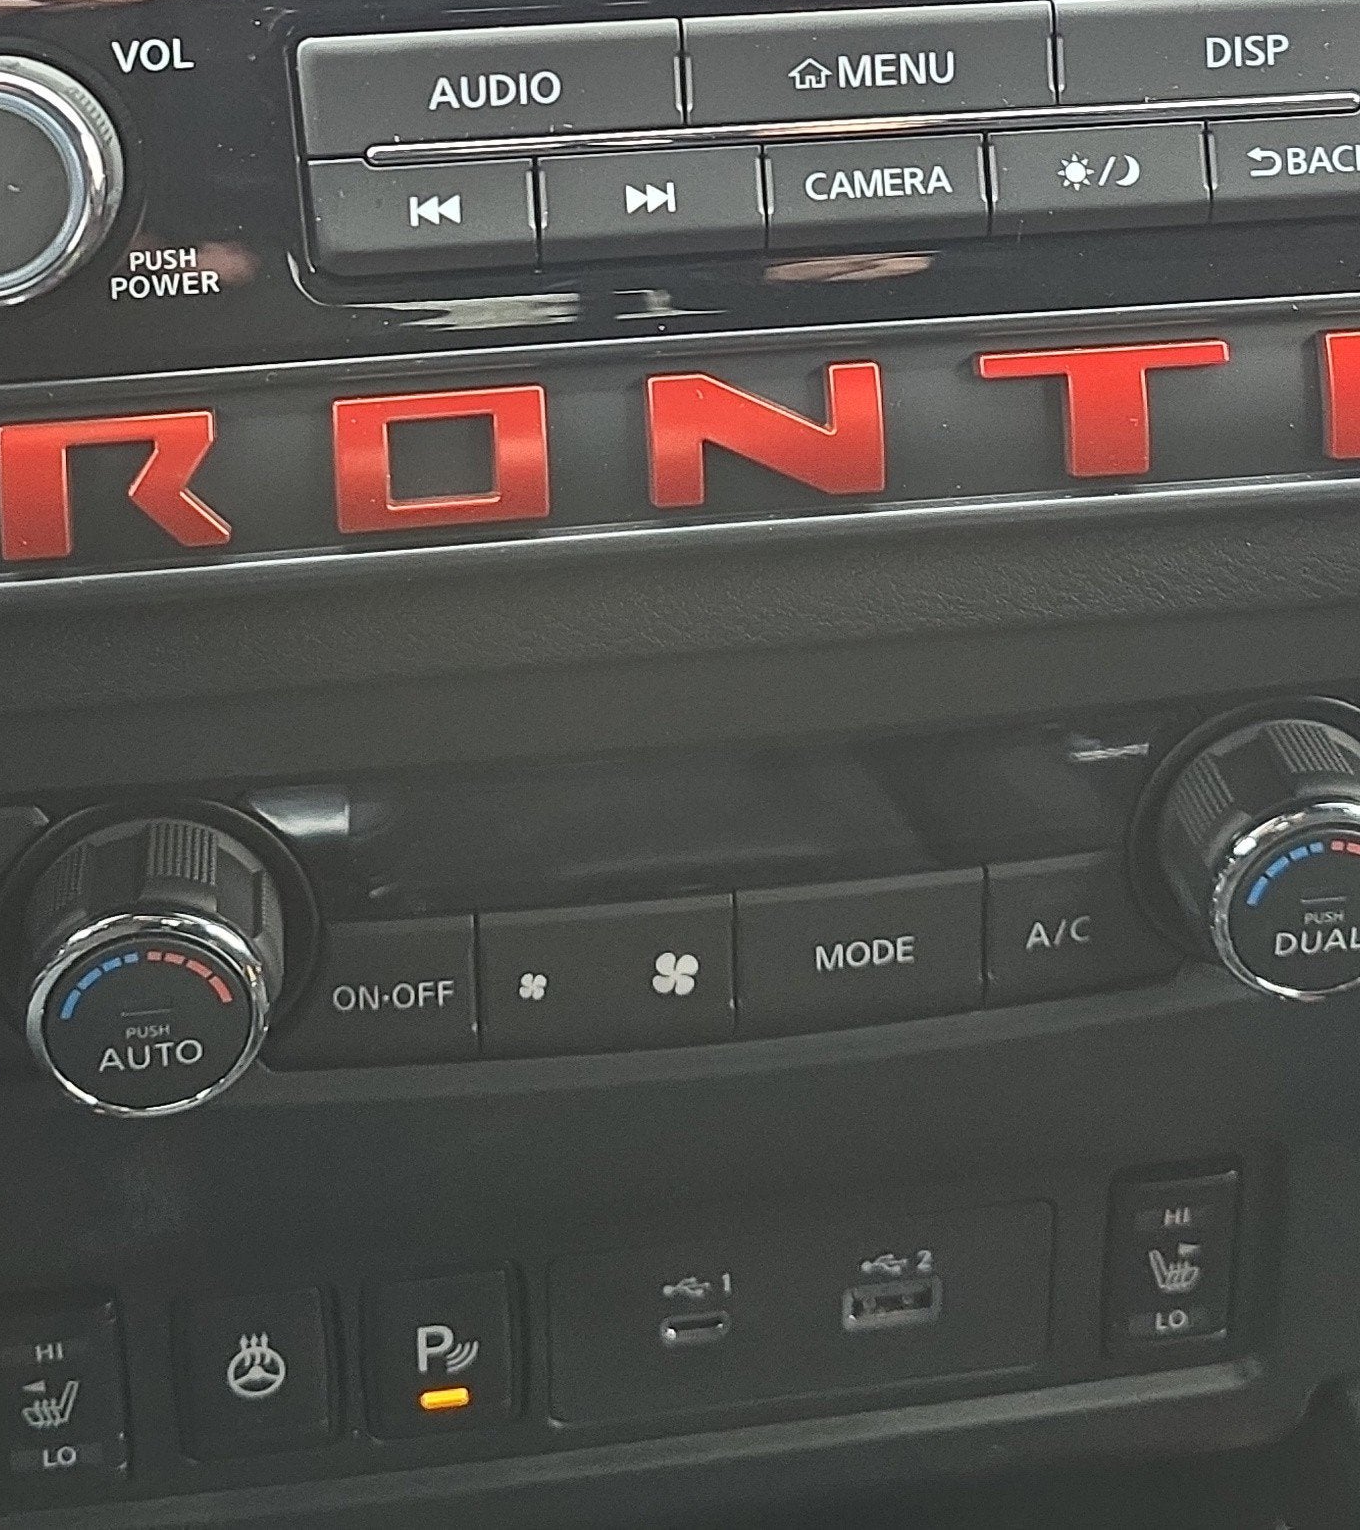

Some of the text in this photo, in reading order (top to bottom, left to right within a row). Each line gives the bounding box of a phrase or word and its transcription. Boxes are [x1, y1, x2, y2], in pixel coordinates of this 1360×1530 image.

[111, 38, 194, 72] VOL
[1205, 35, 1289, 70] DISP
[838, 52, 956, 90] MENU
[429, 71, 561, 111] AUDIO
[805, 165, 953, 202] CAMERA
[129, 248, 197, 271] PUSH
[110, 271, 219, 299] POWER
[1304, 911, 1344, 923] PUSH
[1025, 916, 1091, 948] A/C
[814, 936, 915, 971] MODE
[126, 1024, 170, 1039] PUSH
[99, 1039, 204, 1073] AUTO
[1164, 1207, 1190, 1227] HI
[917, 1251, 932, 1269] 2
[721, 1274, 731, 1292] 1
[1156, 1309, 1187, 1329] LO
[35, 1343, 63, 1361] HI
[417, 1325, 452, 1372] P
[43, 1446, 76, 1467] LO
